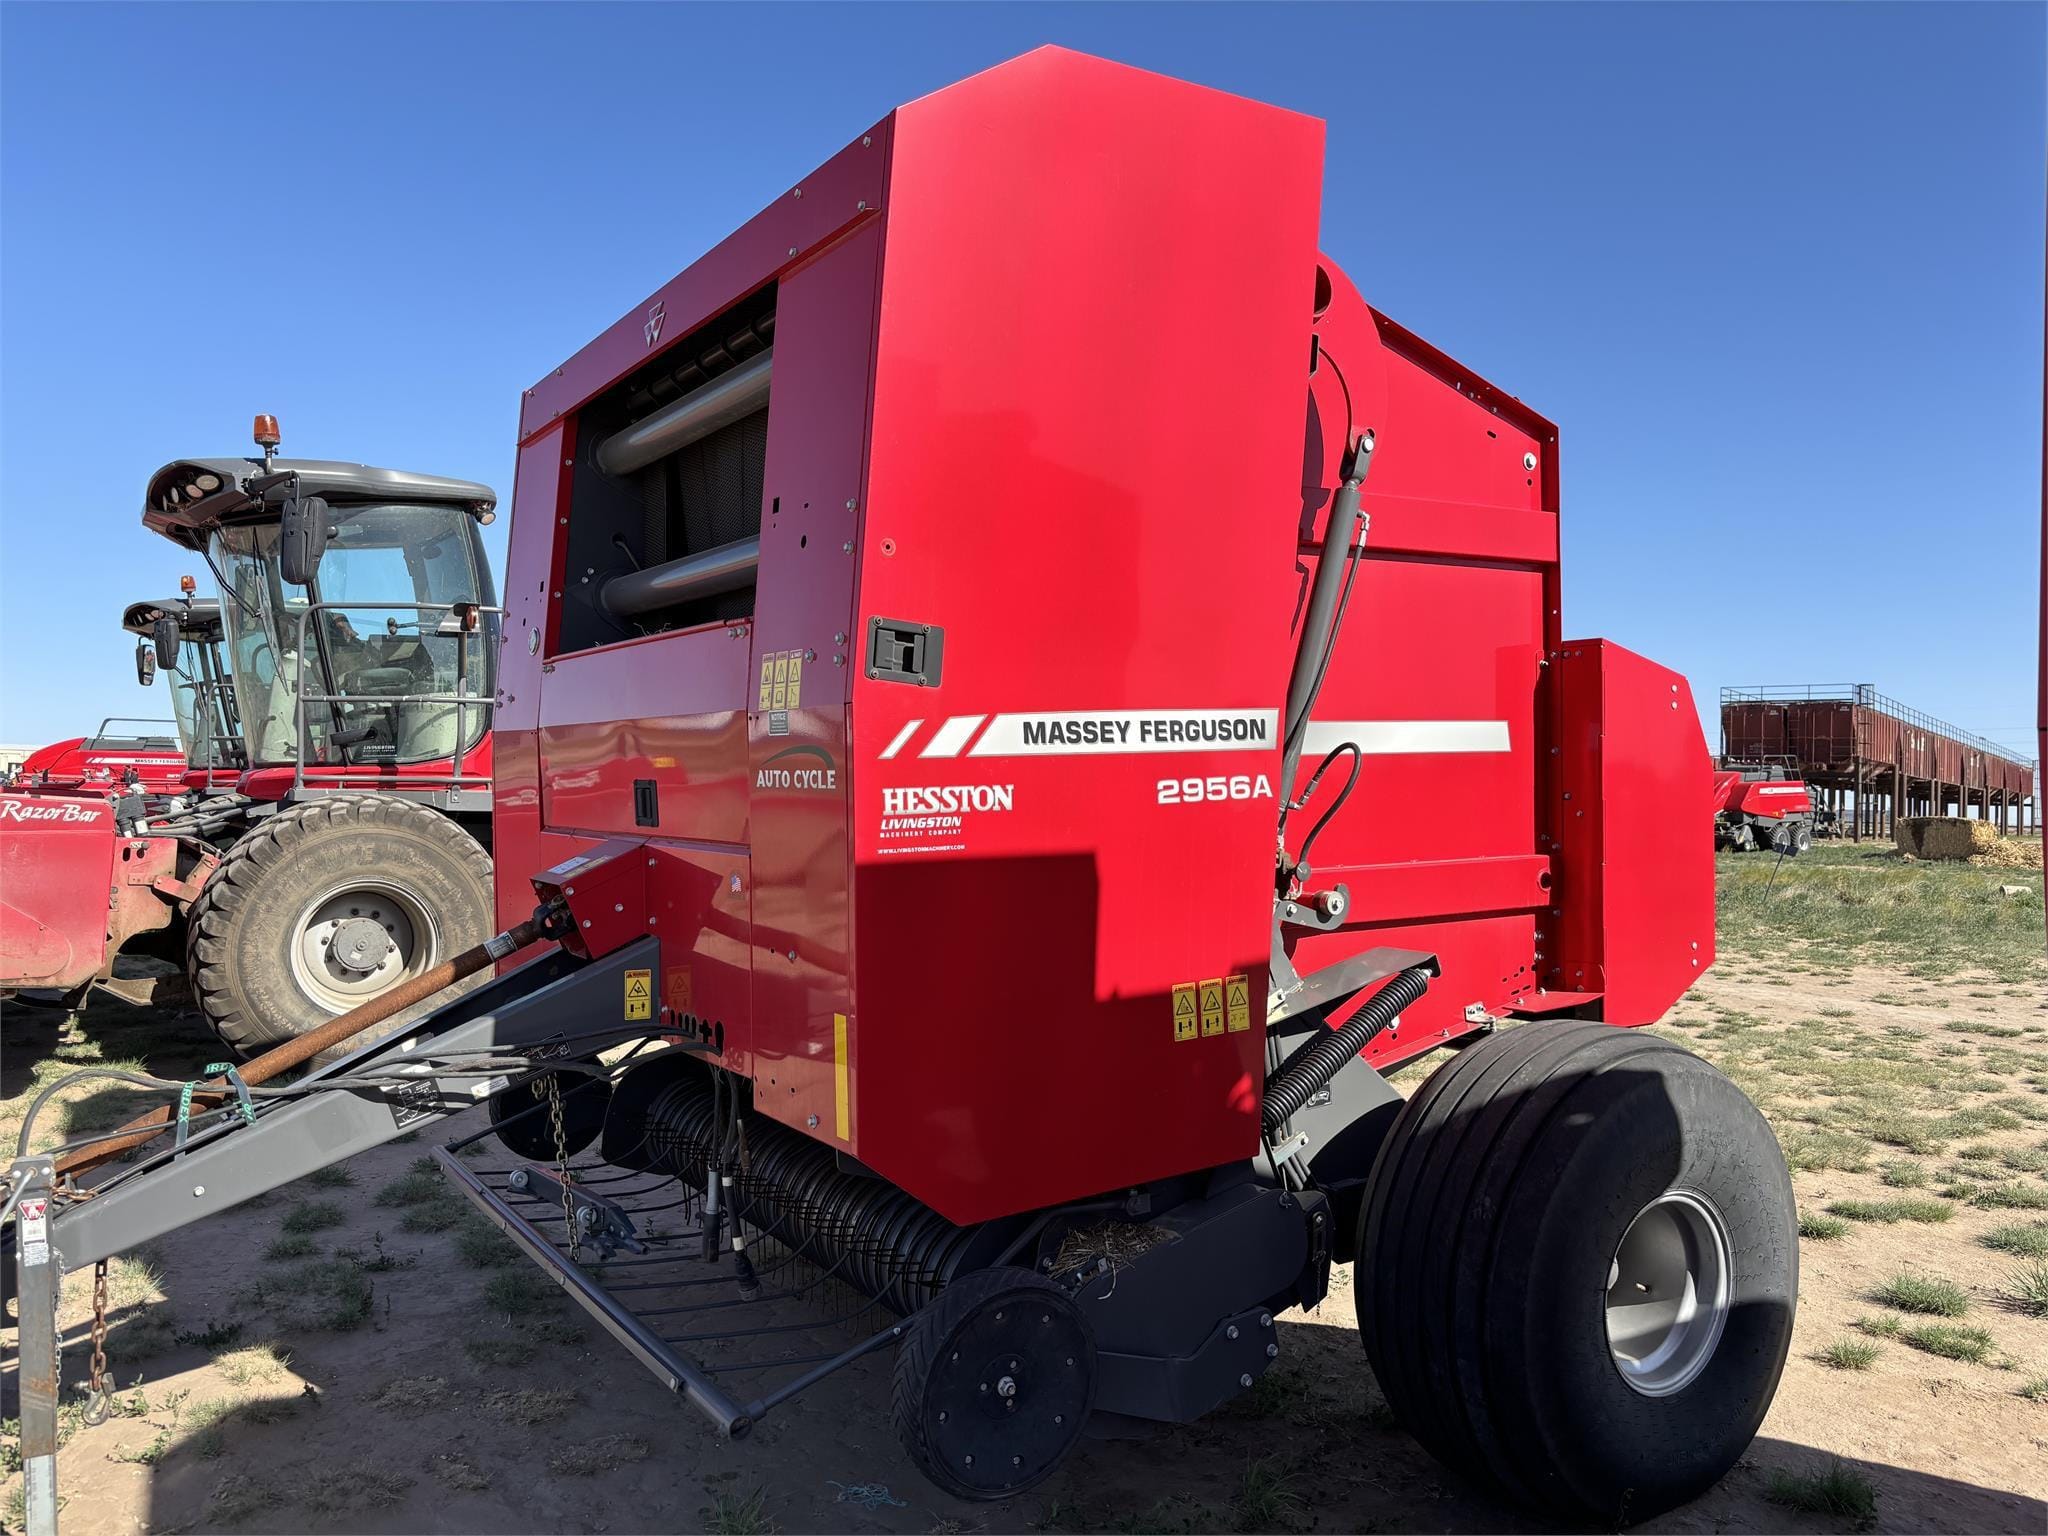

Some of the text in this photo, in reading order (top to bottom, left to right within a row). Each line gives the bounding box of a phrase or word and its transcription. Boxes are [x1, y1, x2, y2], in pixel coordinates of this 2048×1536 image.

[1023, 718, 1266, 745] MASSEY FERGUSON
[756, 769, 836, 789] AUTO CYCLE
[1157, 774, 1274, 805] 2956A
[882, 784, 1014, 816] HESSTON
[879, 829, 962, 839] MACHINERY COMPANY
[880, 816, 962, 830] LIVINGSTON
